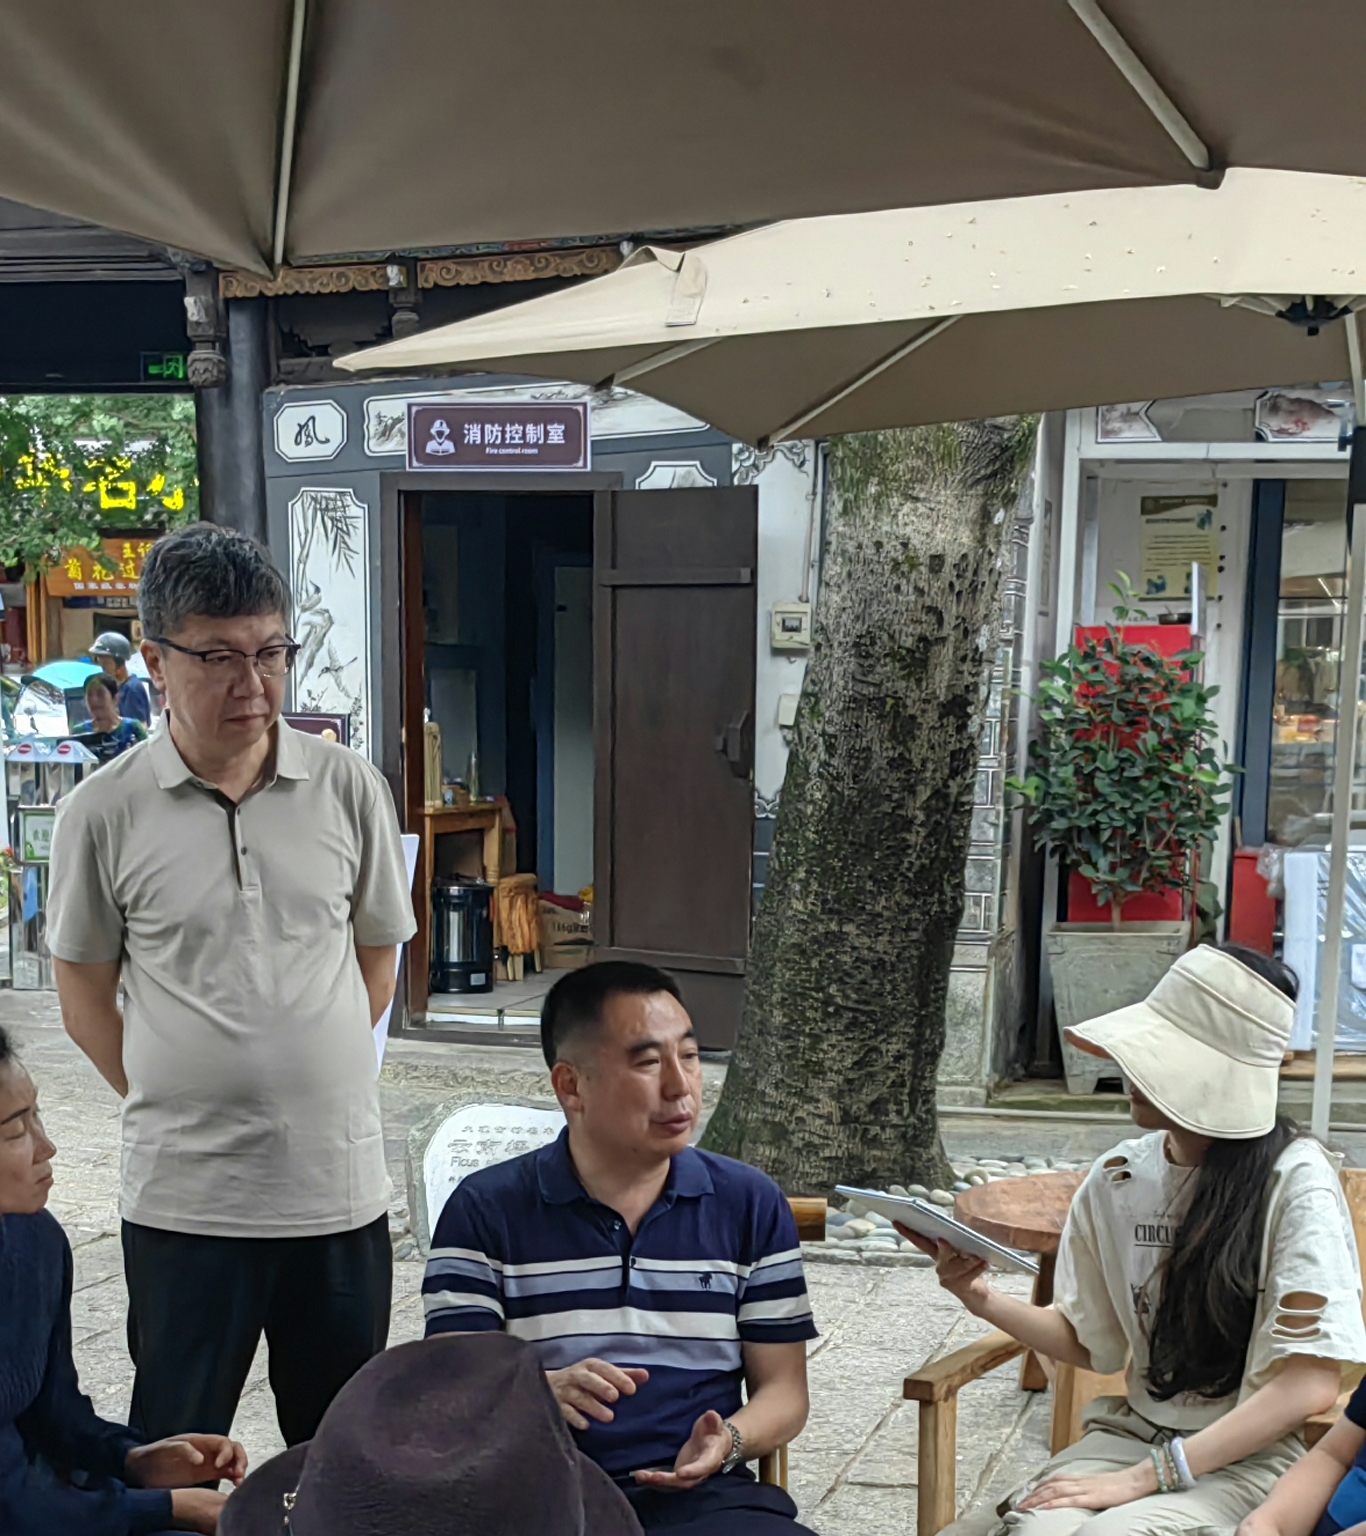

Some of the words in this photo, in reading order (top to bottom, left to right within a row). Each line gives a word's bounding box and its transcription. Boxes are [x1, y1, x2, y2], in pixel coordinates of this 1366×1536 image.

[463, 422, 566, 445] 消防控制室
